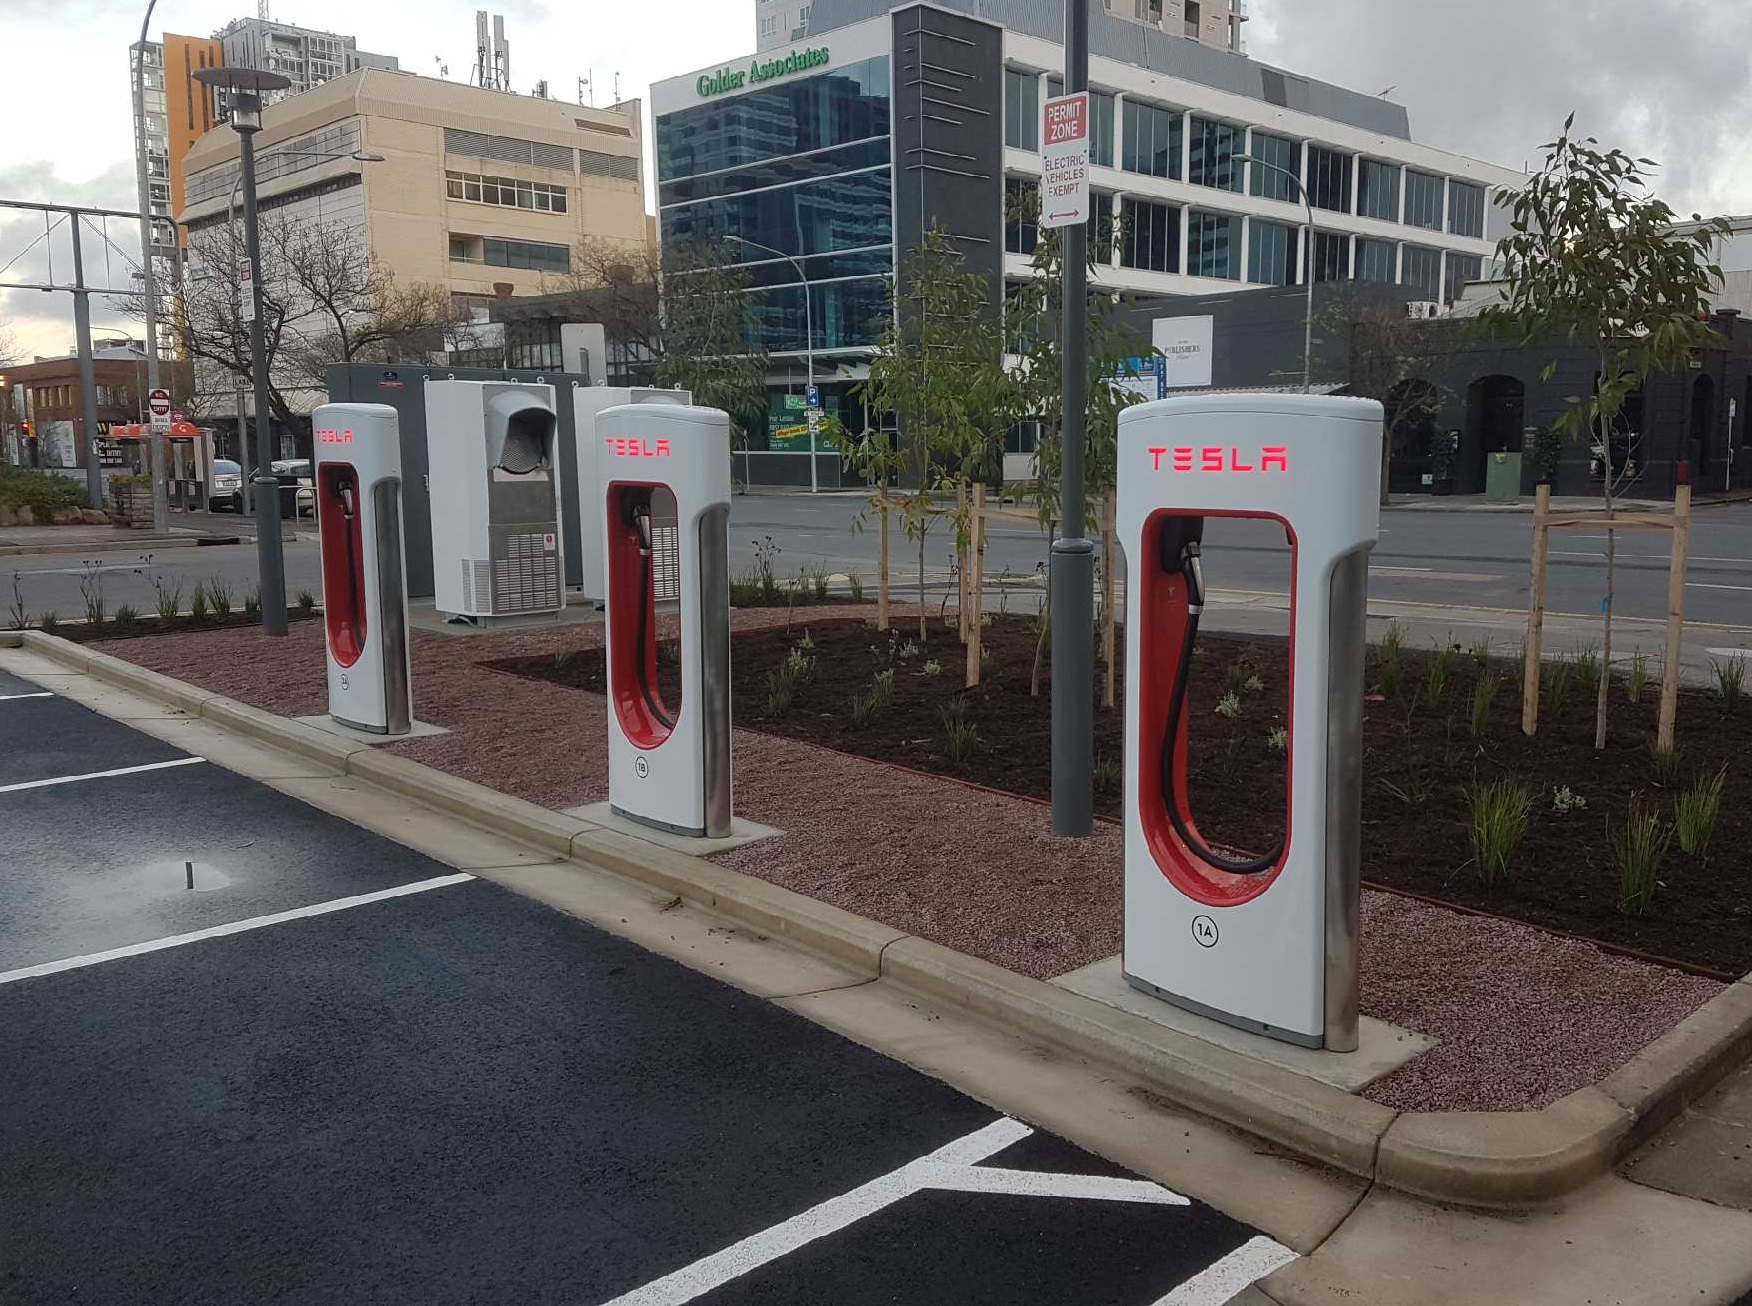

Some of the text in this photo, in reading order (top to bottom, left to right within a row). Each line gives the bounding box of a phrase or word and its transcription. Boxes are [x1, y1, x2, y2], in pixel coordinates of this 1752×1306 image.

[696, 46, 829, 97] Golder Associates
[1048, 101, 1082, 123] PERMIT
[1050, 120, 1078, 141] ZONE
[1045, 154, 1085, 172] ELECTRIC
[1046, 168, 1085, 185] VEHICLES
[1048, 182, 1080, 198] EXEMPT
[809, 388, 816, 397] P
[315, 428, 353, 443] TESLA
[606, 438, 671, 458] TESLA
[1148, 447, 1288, 472] TESLA
[638, 763, 645, 771] 1B
[1197, 923, 1212, 938] 1A
